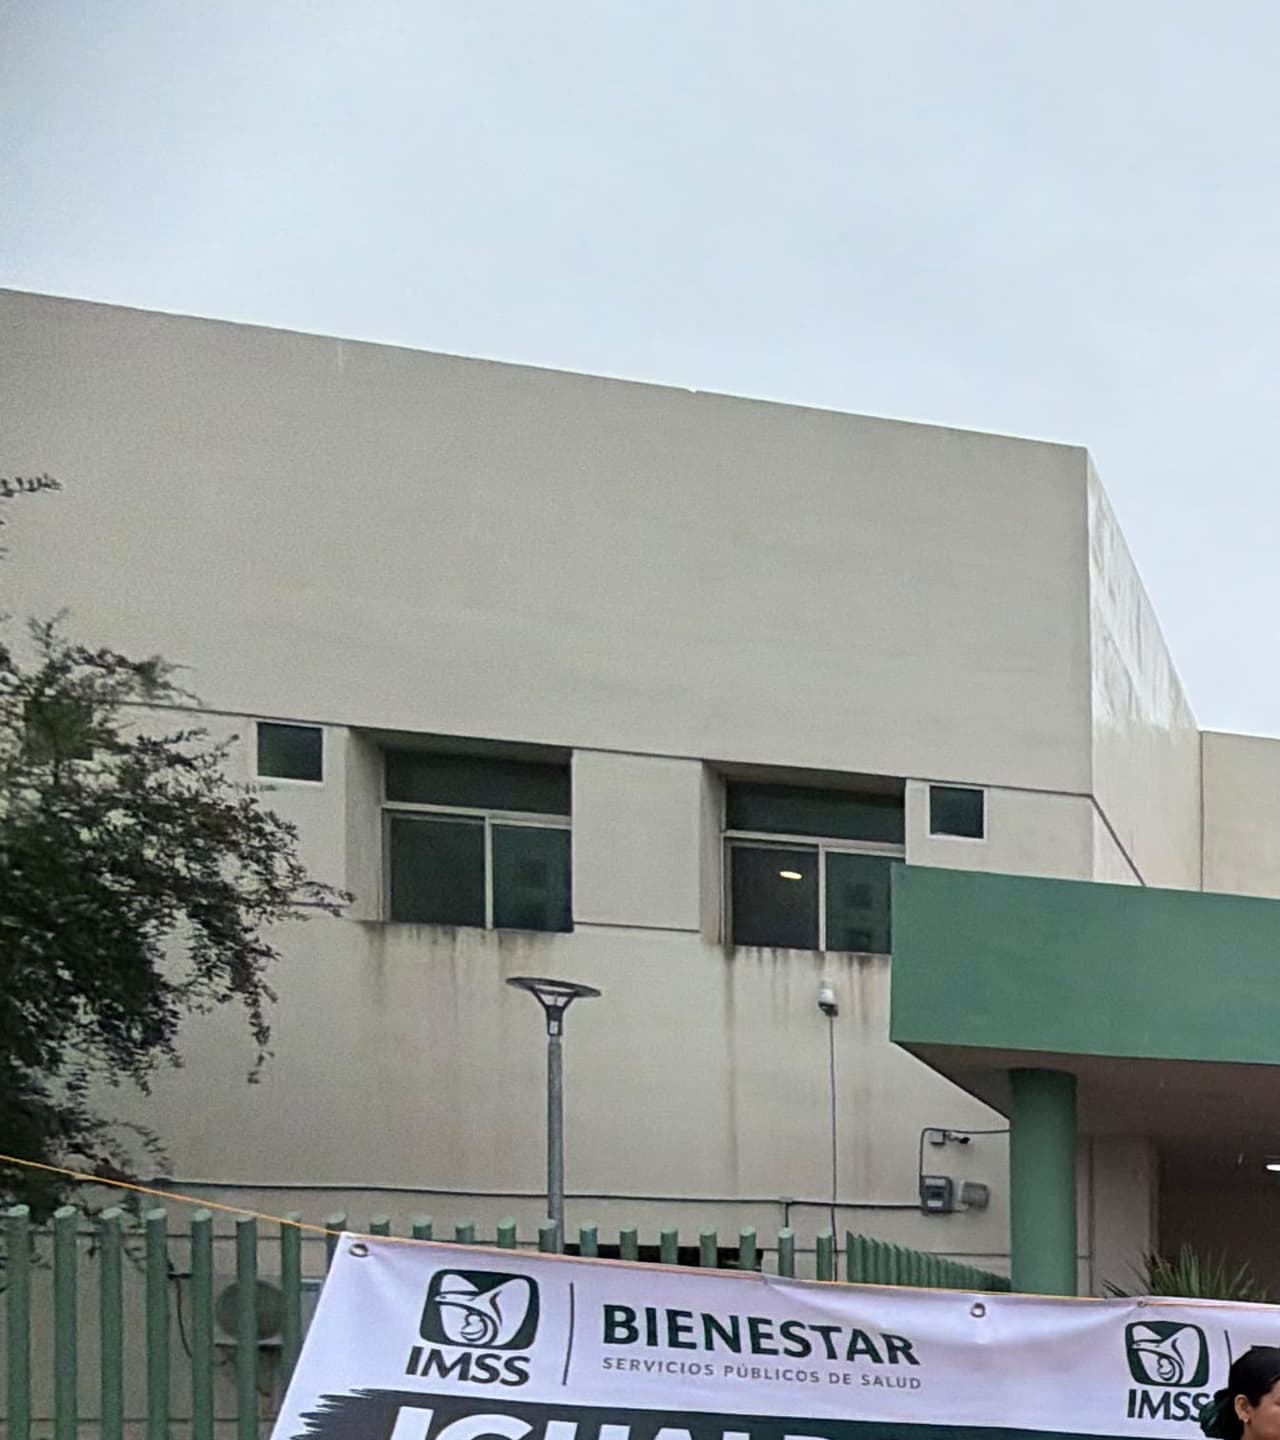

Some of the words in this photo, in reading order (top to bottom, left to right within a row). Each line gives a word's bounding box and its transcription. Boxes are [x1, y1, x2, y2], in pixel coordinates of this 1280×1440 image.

[602, 1304, 922, 1366] BIENESTAR
[405, 1346, 531, 1387] IMSS
[602, 1356, 715, 1377] SERVICIOS
[723, 1361, 820, 1385] PÚBLICOS
[828, 1372, 853, 1386] DE
[860, 1374, 922, 1391] SALUD
[1127, 1389, 1204, 1424] IMSS
